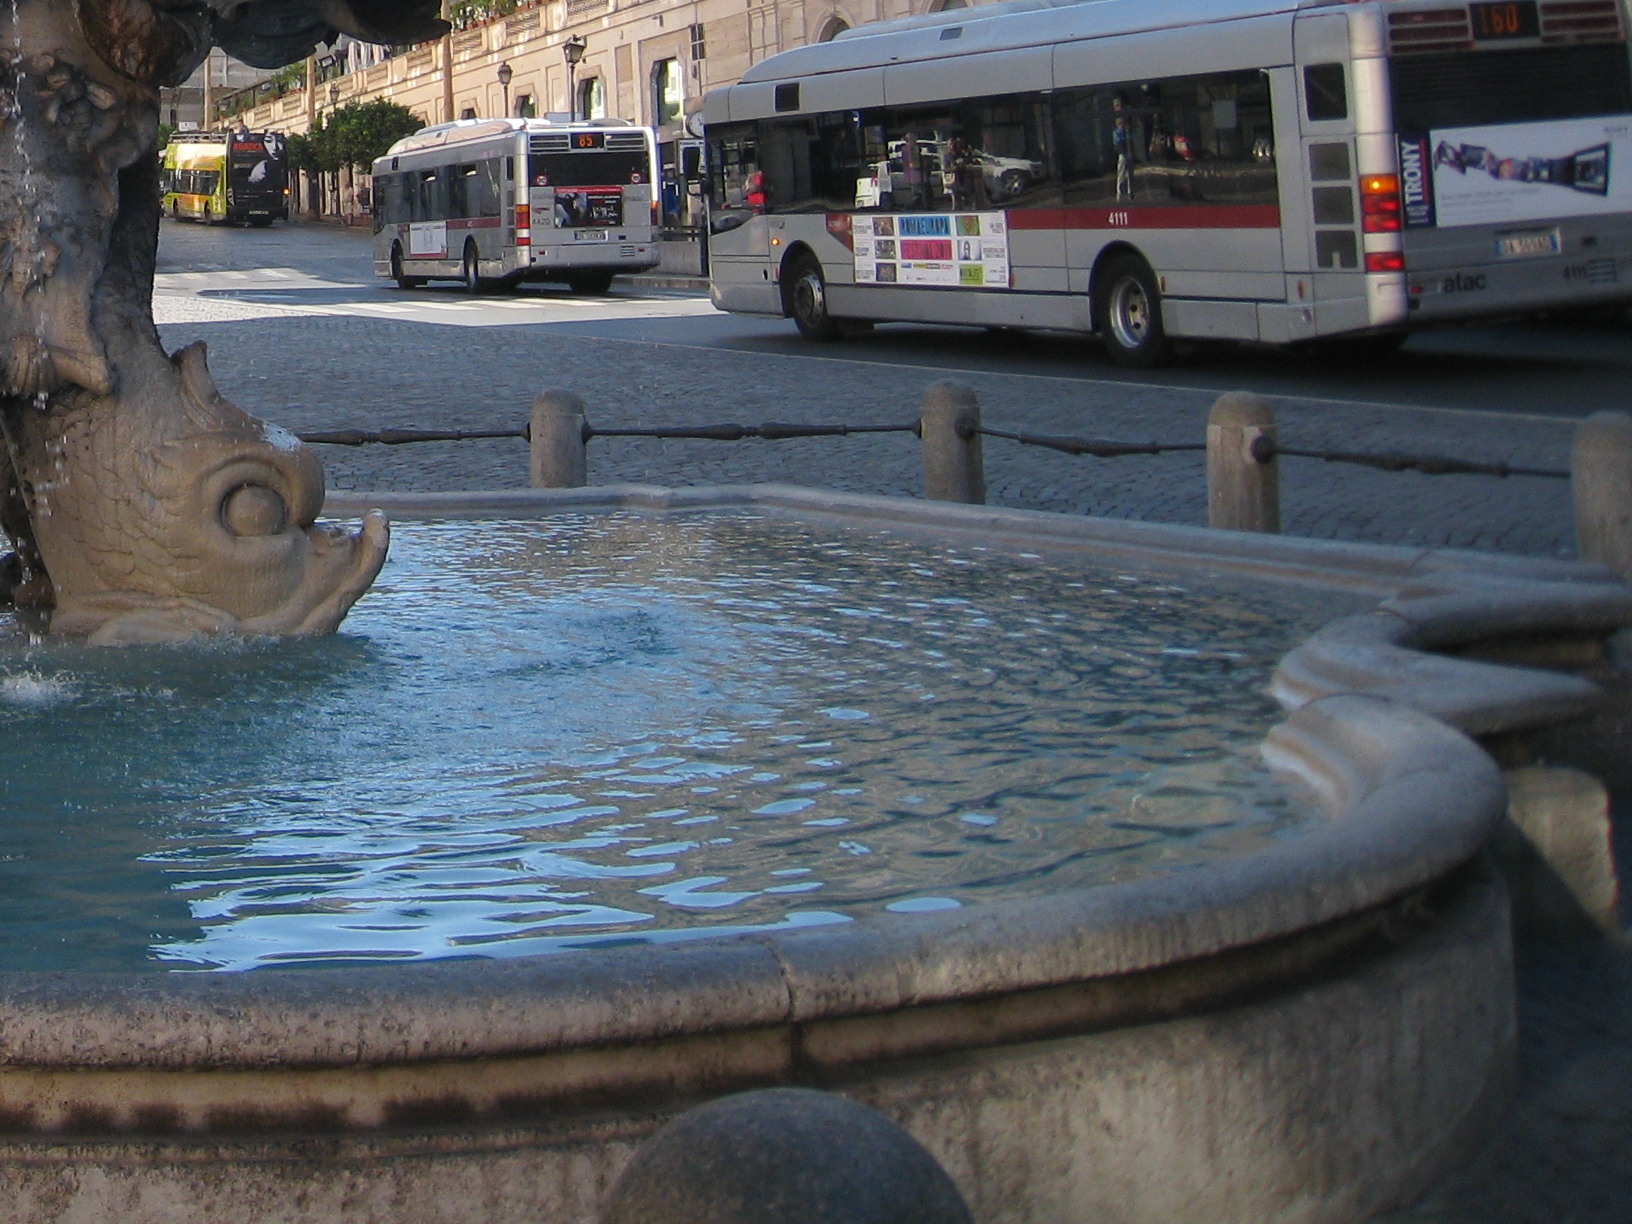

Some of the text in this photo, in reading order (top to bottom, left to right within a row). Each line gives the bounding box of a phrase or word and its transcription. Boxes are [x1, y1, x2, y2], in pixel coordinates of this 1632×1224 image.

[1478, 3, 1519, 34] 160
[578, 134, 593, 147] 85
[1400, 140, 1424, 205] TRONY
[1108, 211, 1128, 226] 4111
[1443, 271, 1486, 294] atac
